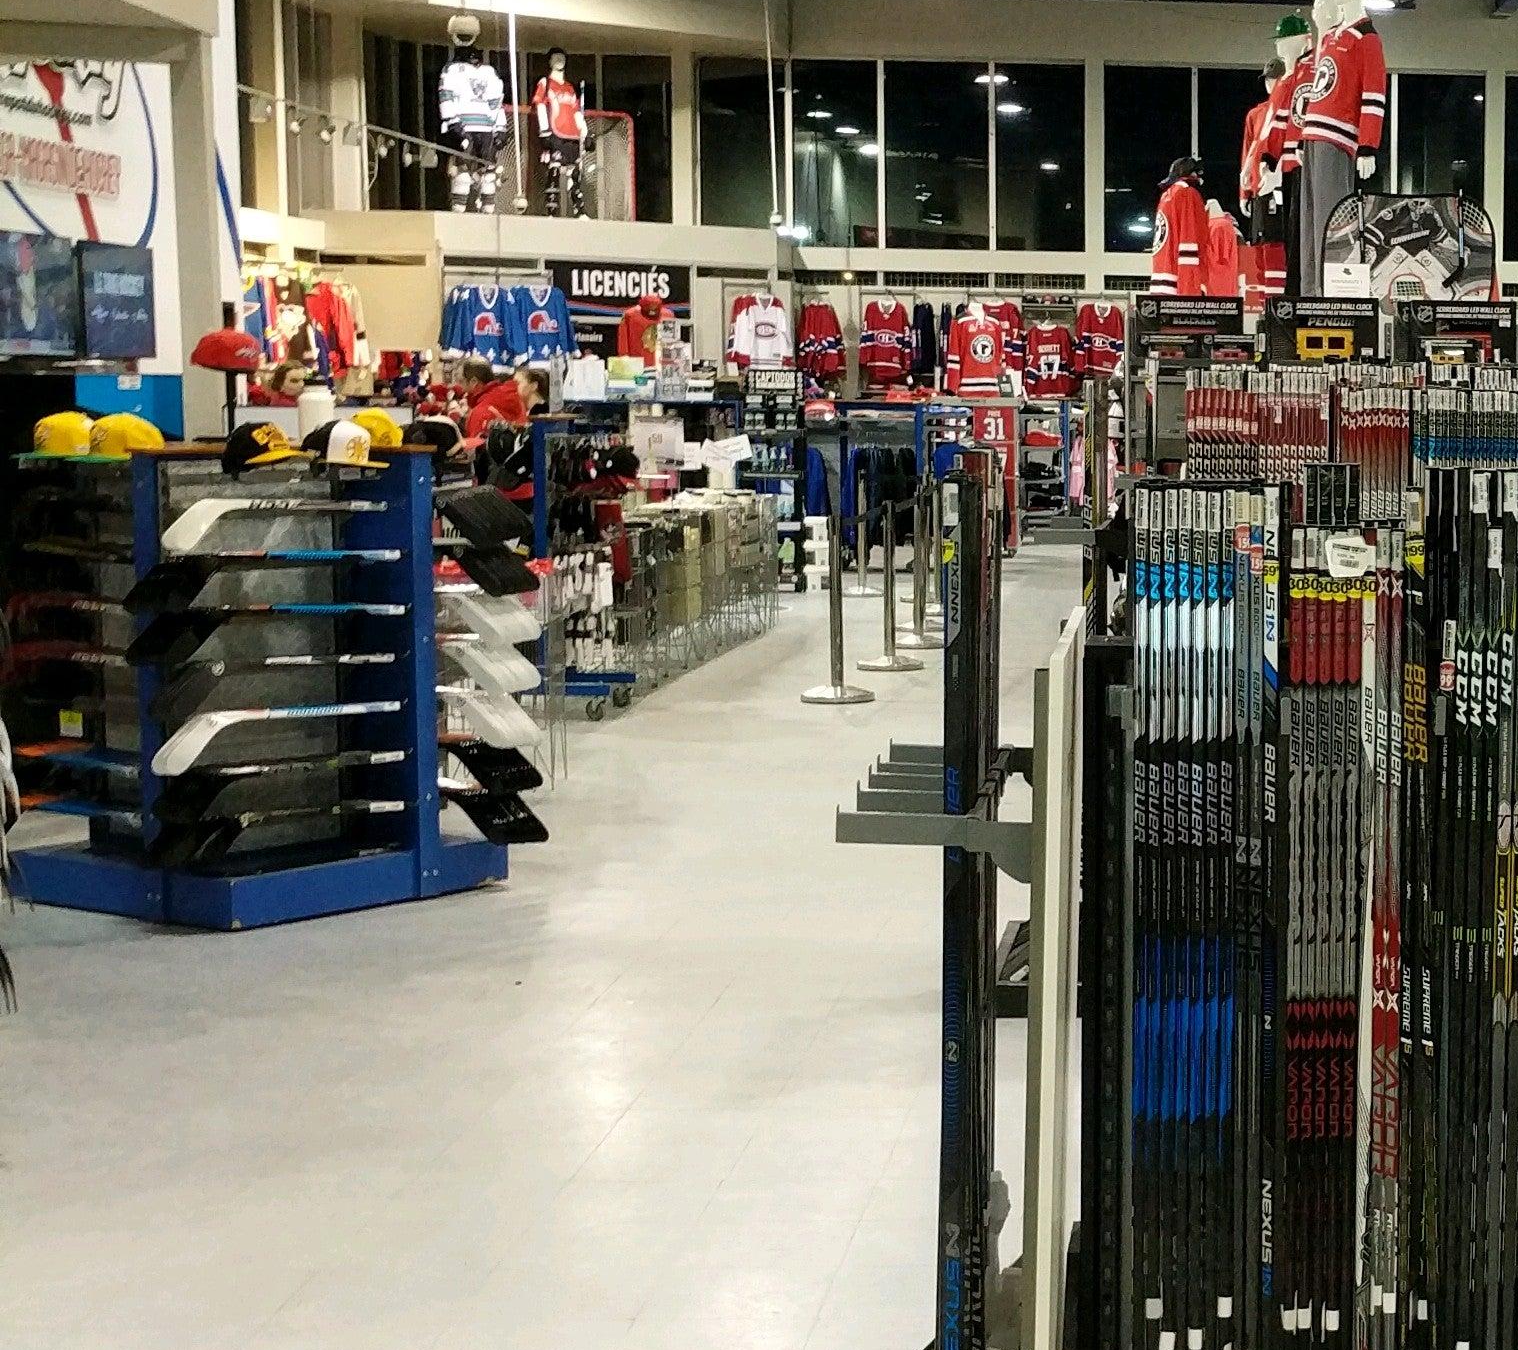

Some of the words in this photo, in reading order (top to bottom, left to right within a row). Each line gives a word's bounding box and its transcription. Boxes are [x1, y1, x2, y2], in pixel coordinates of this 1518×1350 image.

[572, 265, 670, 299] LICENCIÉS
[984, 417, 1006, 440] 31
[1456, 649, 1468, 725] CCM
[1470, 651, 1482, 727] CCM
[1486, 649, 1498, 726] CCM
[1501, 633, 1514, 706] CCM
[1262, 1178, 1272, 1265] NEXUS
